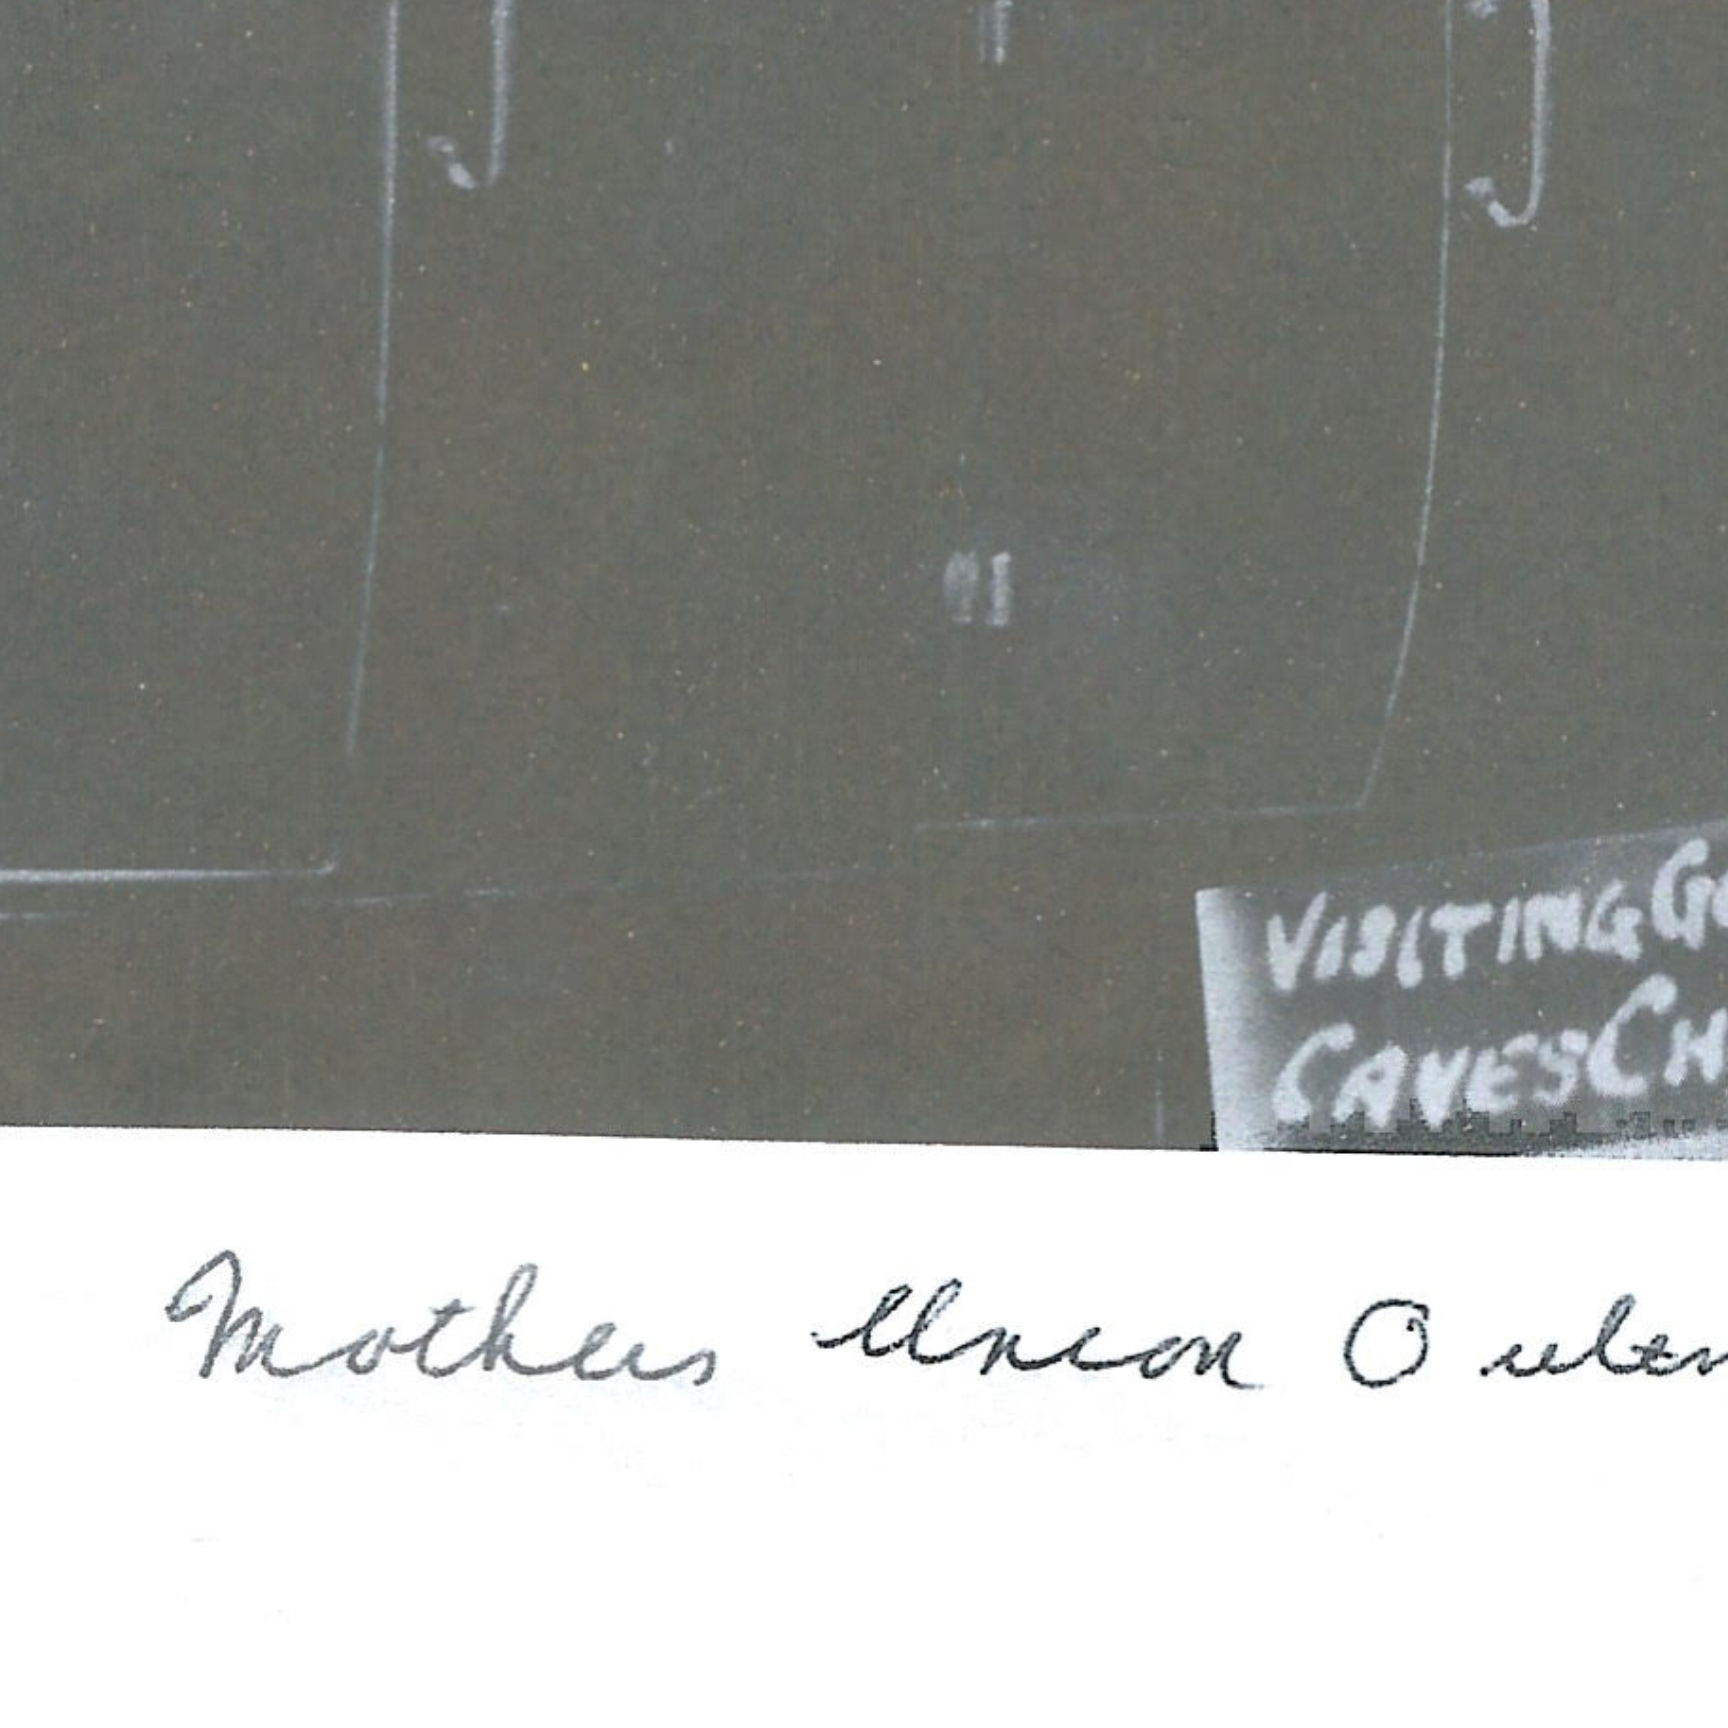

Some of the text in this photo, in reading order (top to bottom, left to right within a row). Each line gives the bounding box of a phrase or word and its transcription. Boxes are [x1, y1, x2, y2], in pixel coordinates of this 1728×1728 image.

[1267, 879, 1643, 992] VISITING
[1272, 1023, 1589, 1127] CAVES
[810, 1277, 1262, 1390] Union
